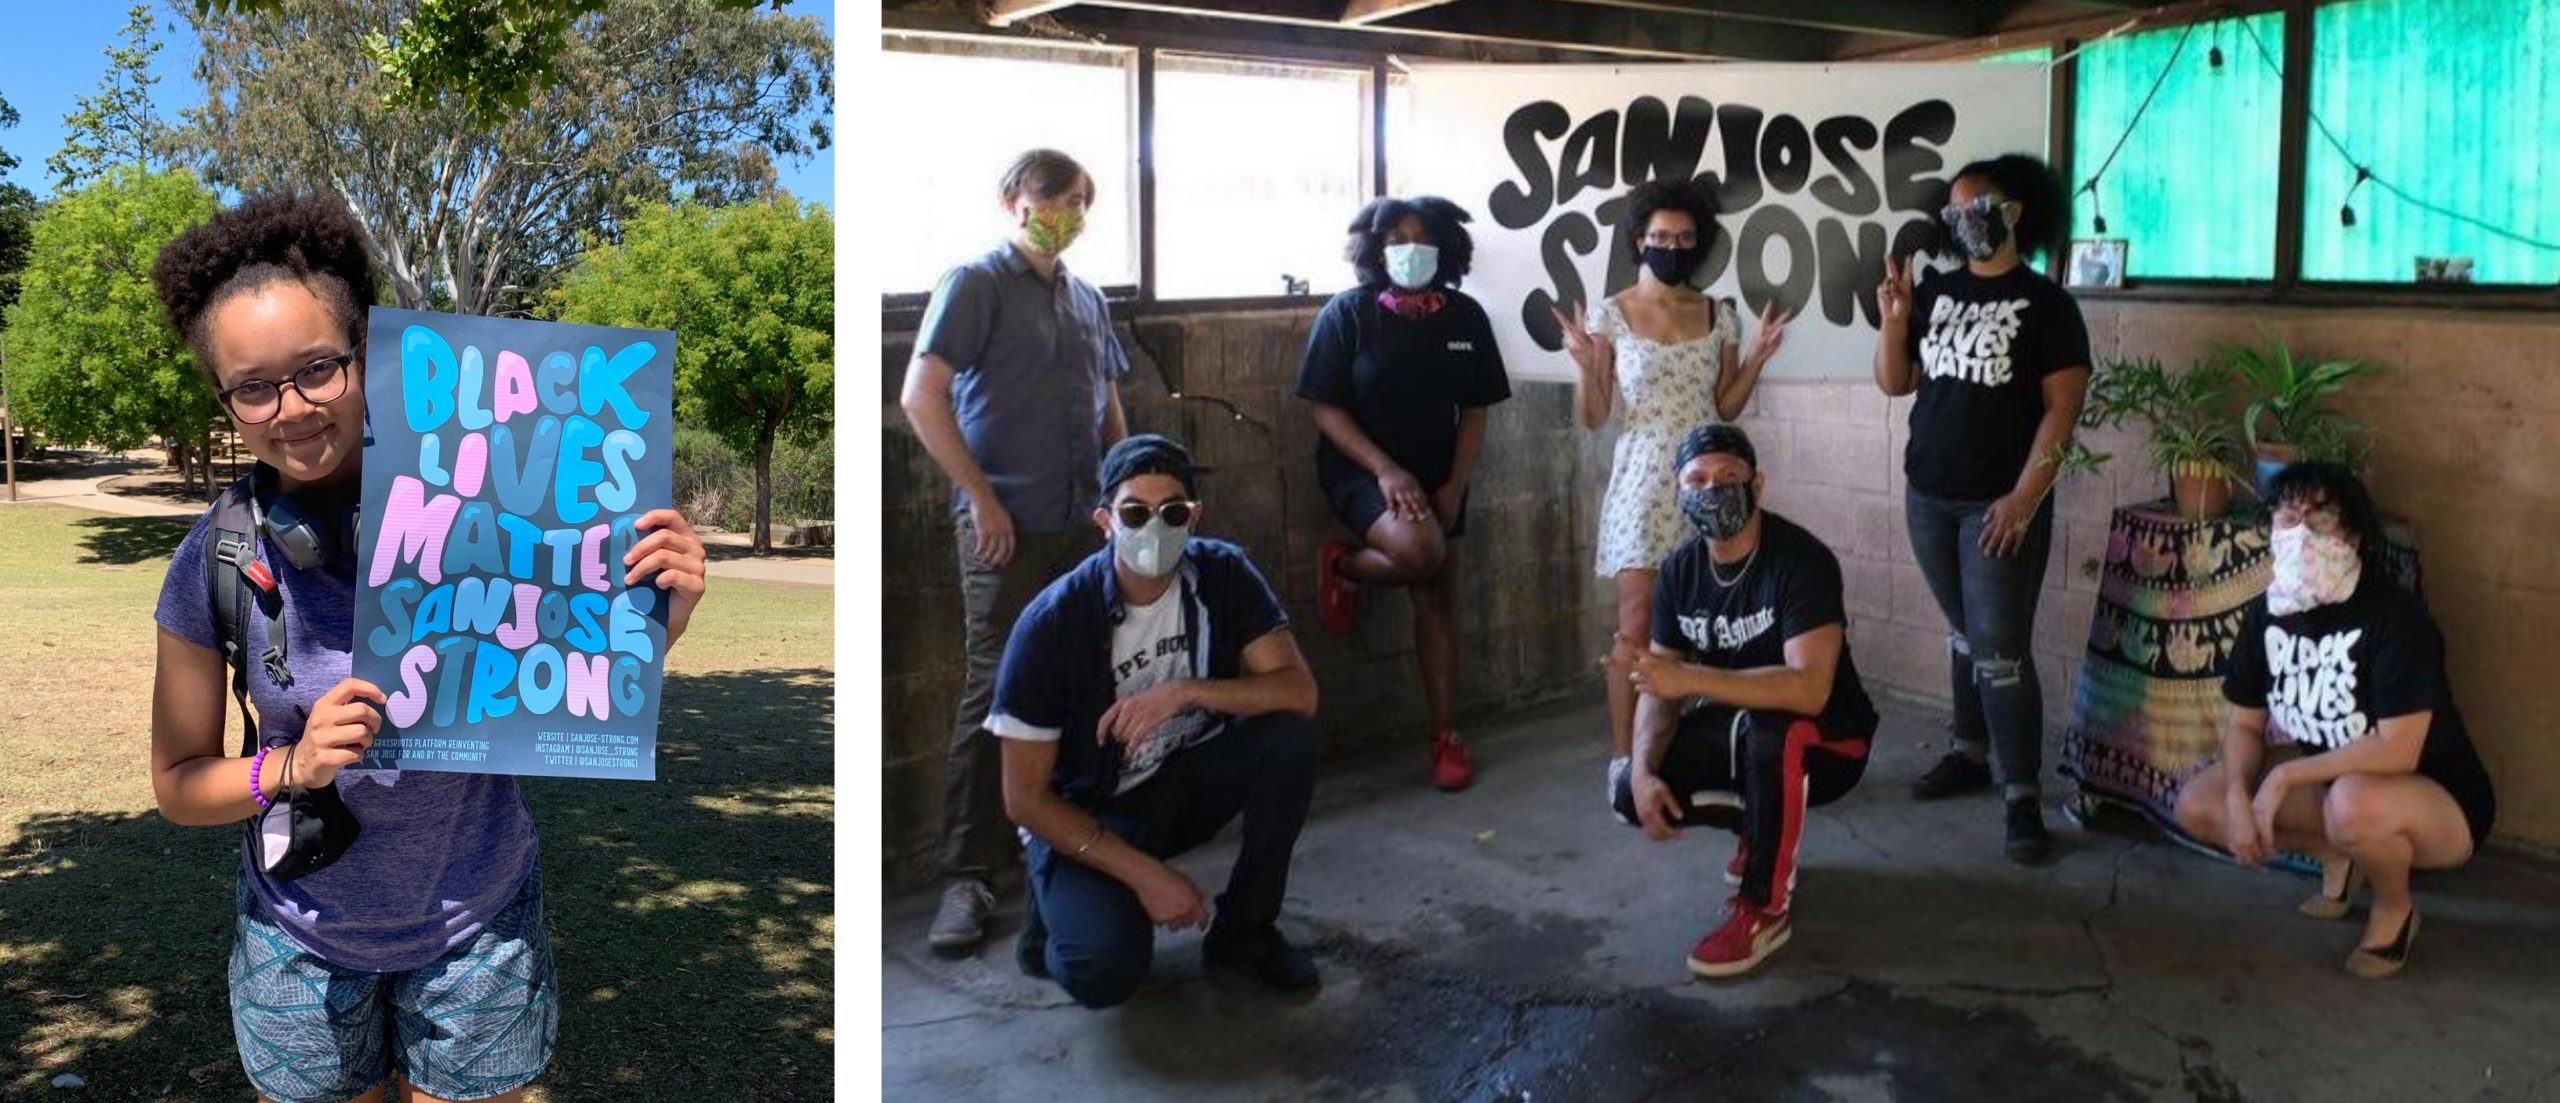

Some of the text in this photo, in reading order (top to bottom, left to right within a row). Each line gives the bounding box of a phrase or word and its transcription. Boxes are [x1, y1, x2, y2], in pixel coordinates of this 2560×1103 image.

[1488, 96, 1956, 229] SANJOSE
[1929, 294, 2031, 327] BLACK
[1926, 320, 2018, 358] LIVES
[402, 324, 656, 432] BLACK
[419, 415, 646, 524] LIVES
[368, 576, 655, 663] SANJOSE
[2264, 625, 2362, 677] BLACK
[385, 636, 645, 728] STRONG
[2272, 666, 2357, 720] LIVES
[365, 749, 487, 762] SAN JOSE FOR AND BY THE COMMUNITY
[373, 738, 490, 750] GRASSROOTS PLATFORM REINVENTING
[535, 743, 570, 754] INSTAGRAM
[537, 731, 565, 742] WEBSITE
[570, 733, 639, 745] SANJOSE-STRONG.COM
[545, 755, 573, 766] TWITTER
